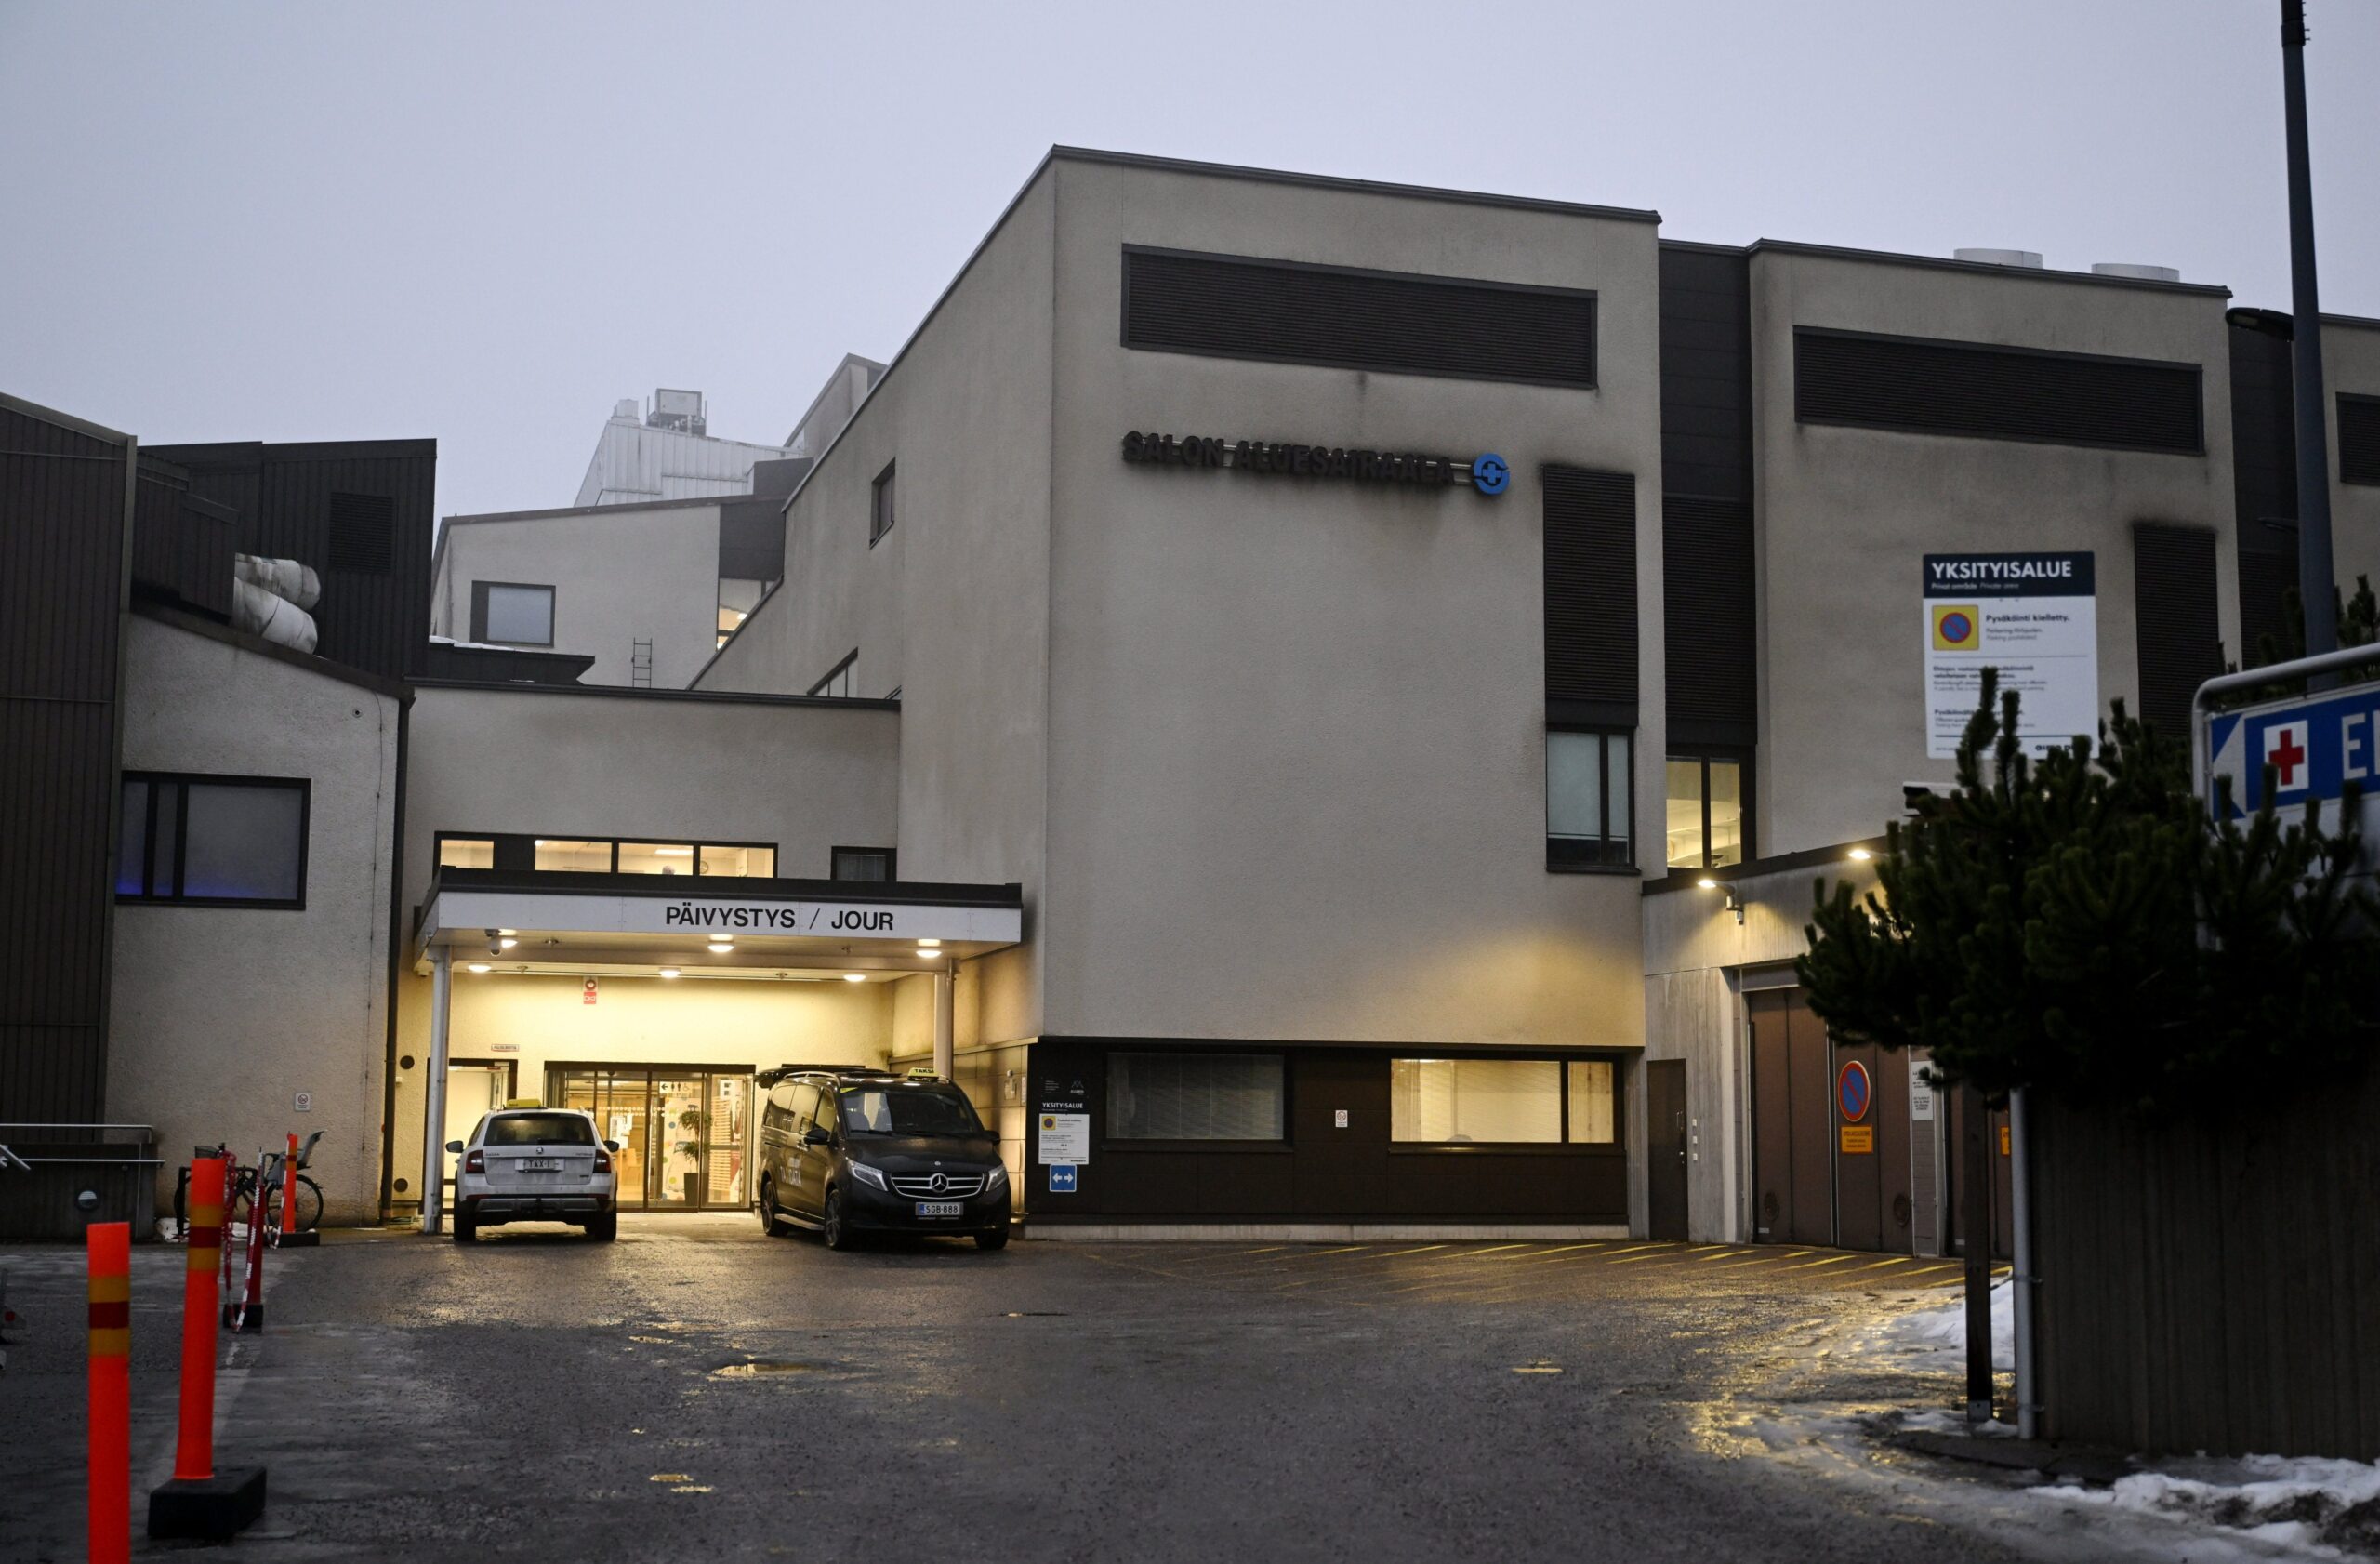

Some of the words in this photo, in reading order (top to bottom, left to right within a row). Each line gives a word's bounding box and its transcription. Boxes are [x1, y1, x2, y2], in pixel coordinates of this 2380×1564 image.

[1122, 431, 1224, 468] SALON
[1235, 440, 1455, 484] ALUESAIRAALA
[1931, 560, 2072, 578] YKSITYISALUE
[1986, 614, 2030, 624] Pysäköinti
[666, 901, 796, 930] PÄIVYSTYS
[810, 907, 821, 930] /
[831, 908, 894, 932] JOUR
